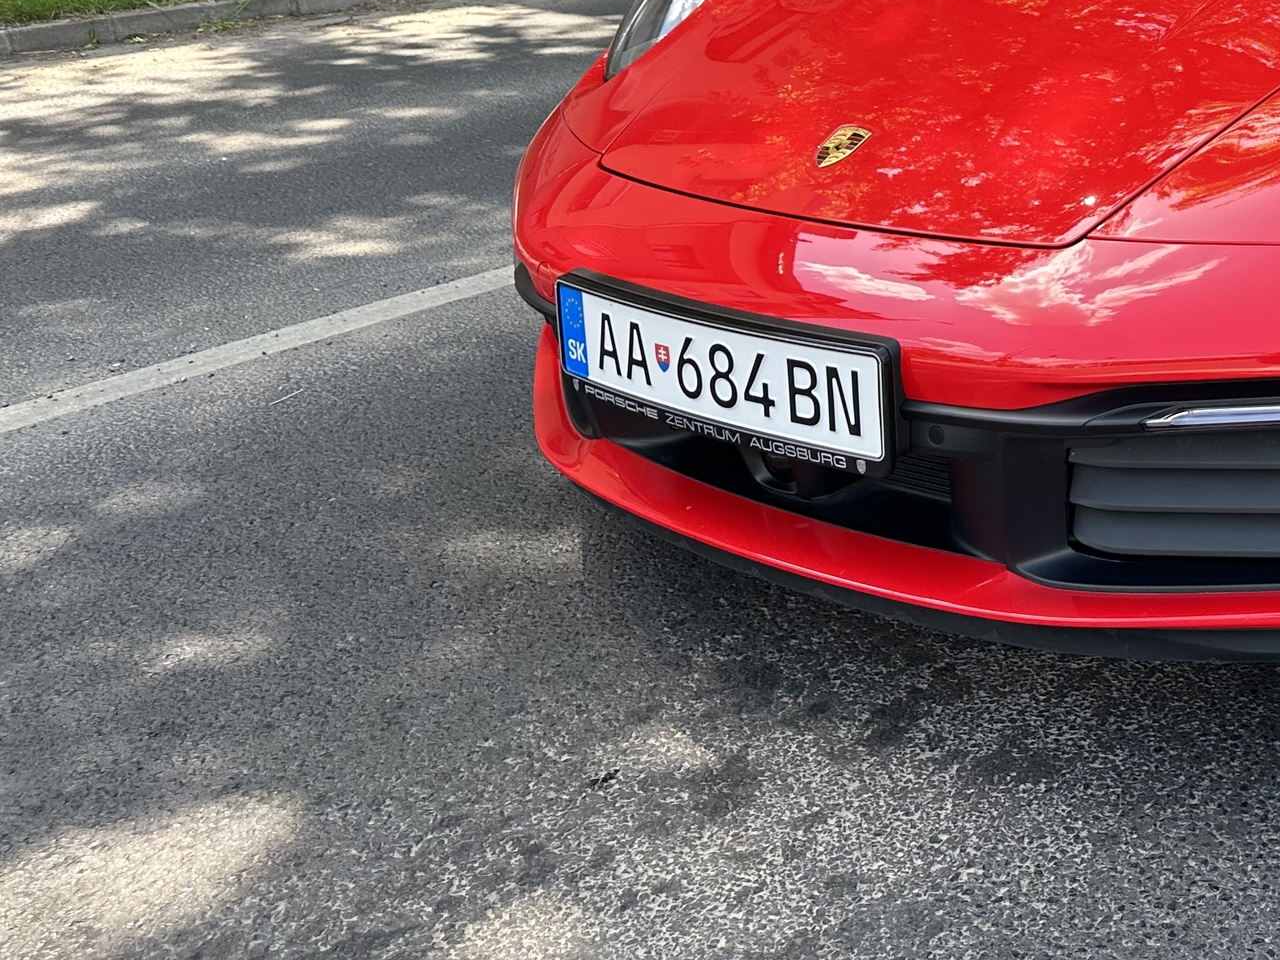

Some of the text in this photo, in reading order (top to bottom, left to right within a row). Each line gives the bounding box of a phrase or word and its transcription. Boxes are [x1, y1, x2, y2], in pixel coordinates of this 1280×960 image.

[568, 338, 587, 364] SK
[584, 385, 847, 469] PORSCHE ZENTRUM AUGSBURG
